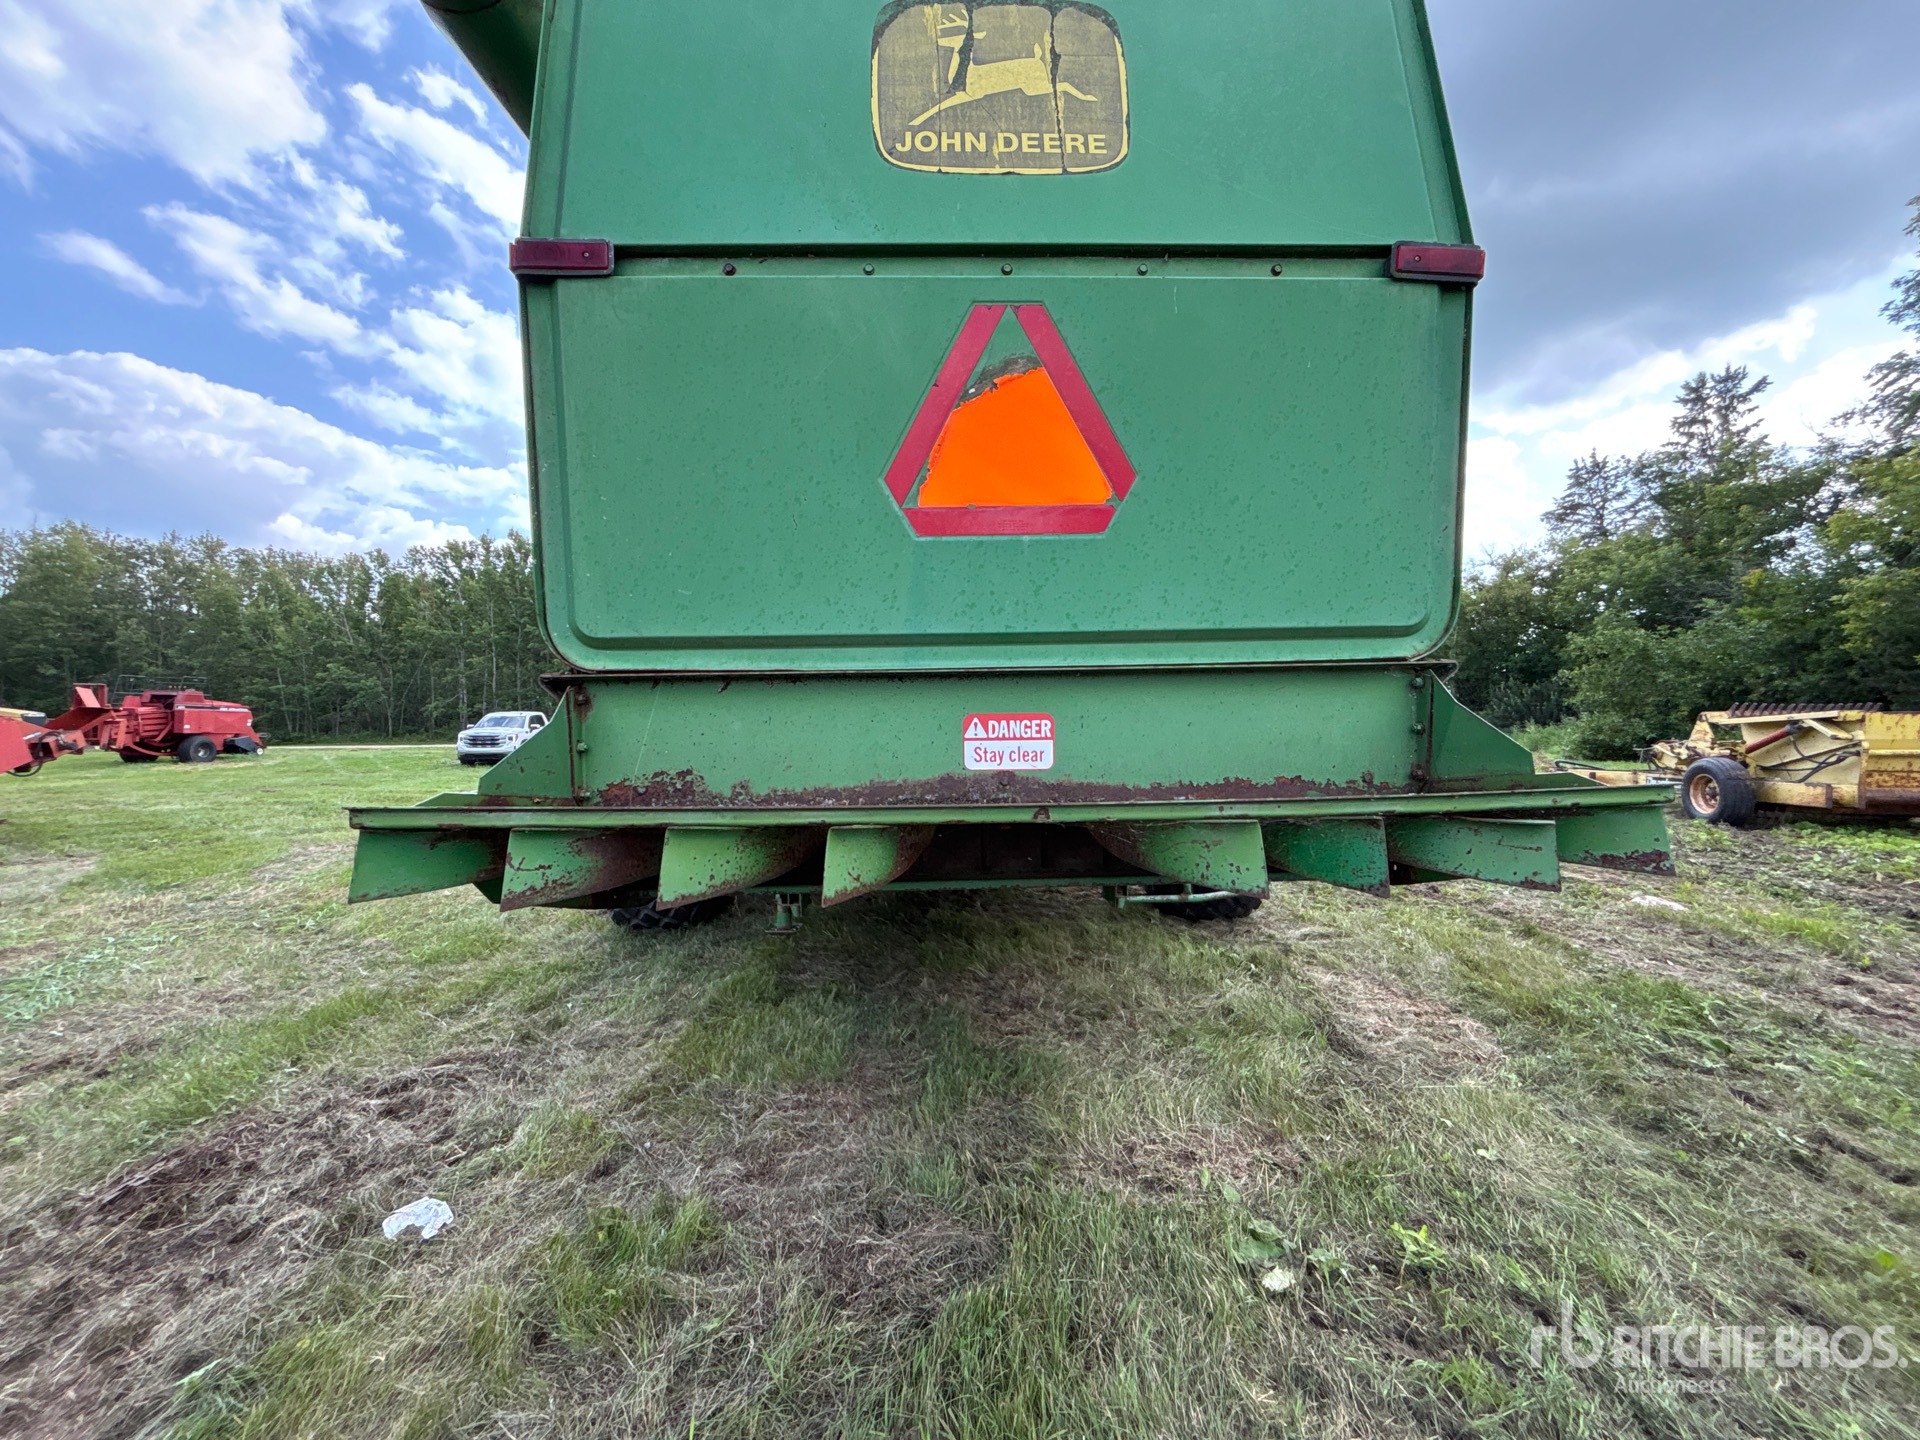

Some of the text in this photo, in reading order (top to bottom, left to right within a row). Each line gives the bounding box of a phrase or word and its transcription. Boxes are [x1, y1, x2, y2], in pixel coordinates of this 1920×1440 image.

[895, 131, 1108, 154] JOHN DEERE
[988, 719, 1052, 738] DANGER
[974, 746, 1045, 766] Stay clear
